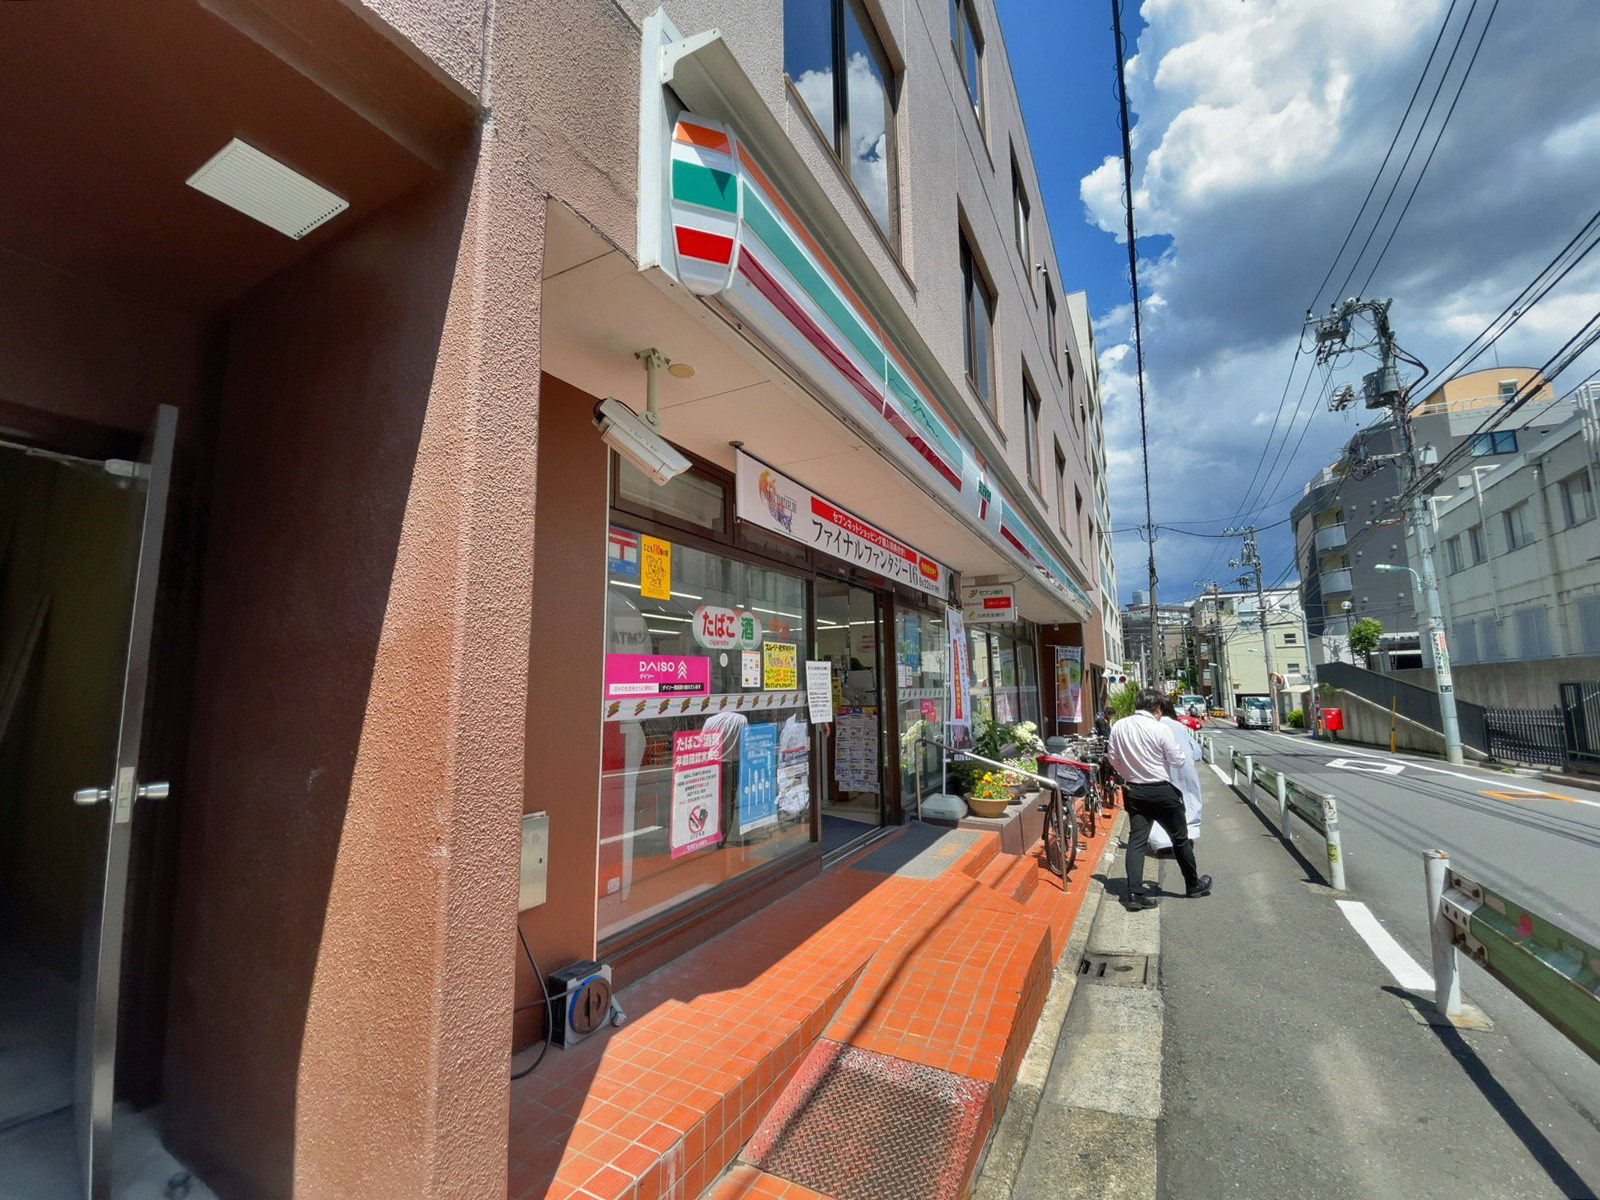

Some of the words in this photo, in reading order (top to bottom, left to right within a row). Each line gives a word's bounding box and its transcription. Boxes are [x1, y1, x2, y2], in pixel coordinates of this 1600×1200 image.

[811, 517, 919, 586] ファイナルファンタジー16
[702, 611, 736, 638] たばこ
[741, 616, 754, 641] 酒
[639, 661, 675, 672] DAISO
